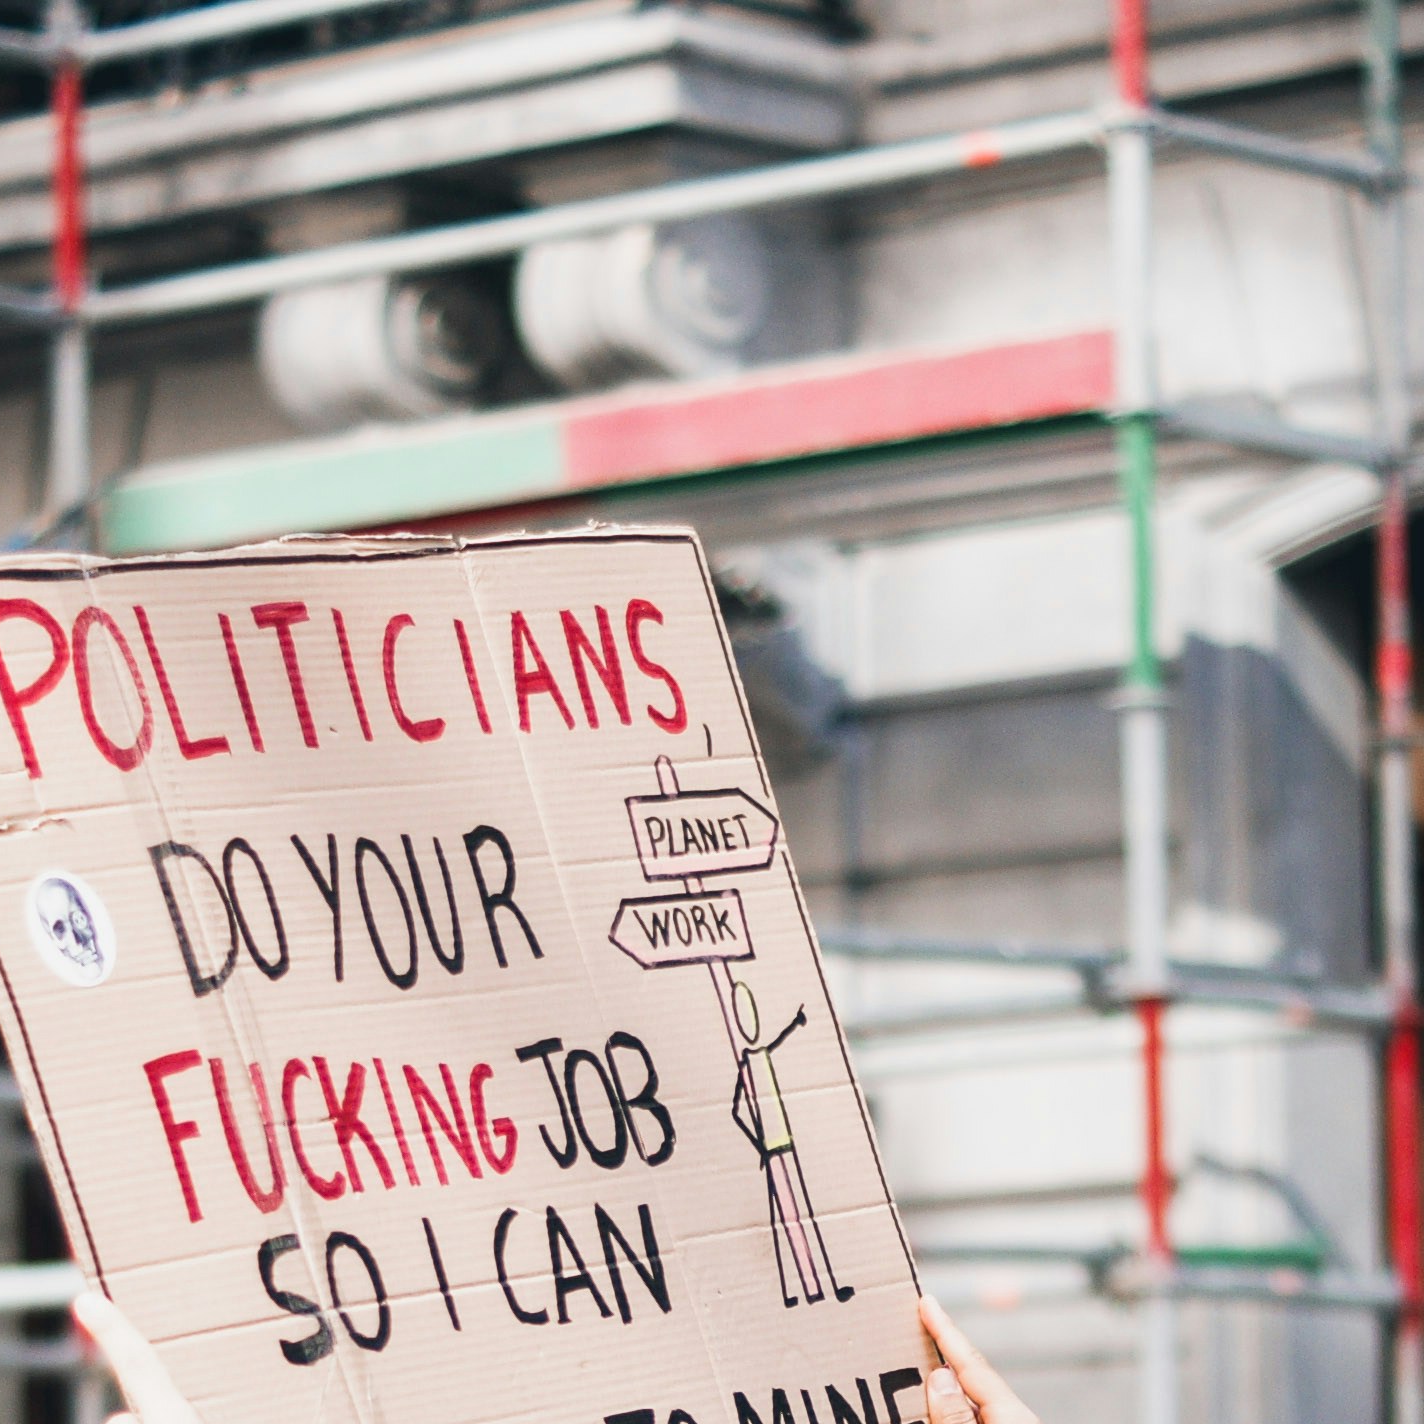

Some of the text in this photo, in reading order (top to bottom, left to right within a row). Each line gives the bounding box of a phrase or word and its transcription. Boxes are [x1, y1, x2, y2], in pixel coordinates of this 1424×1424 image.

[147, 825, 543, 998] DO YOUR
[645, 813, 751, 859] PLANET
[633, 903, 737, 949] WORK
[143, 1031, 676, 1223] FUCKING JOB
[258, 1203, 672, 1366] SO I CAN
